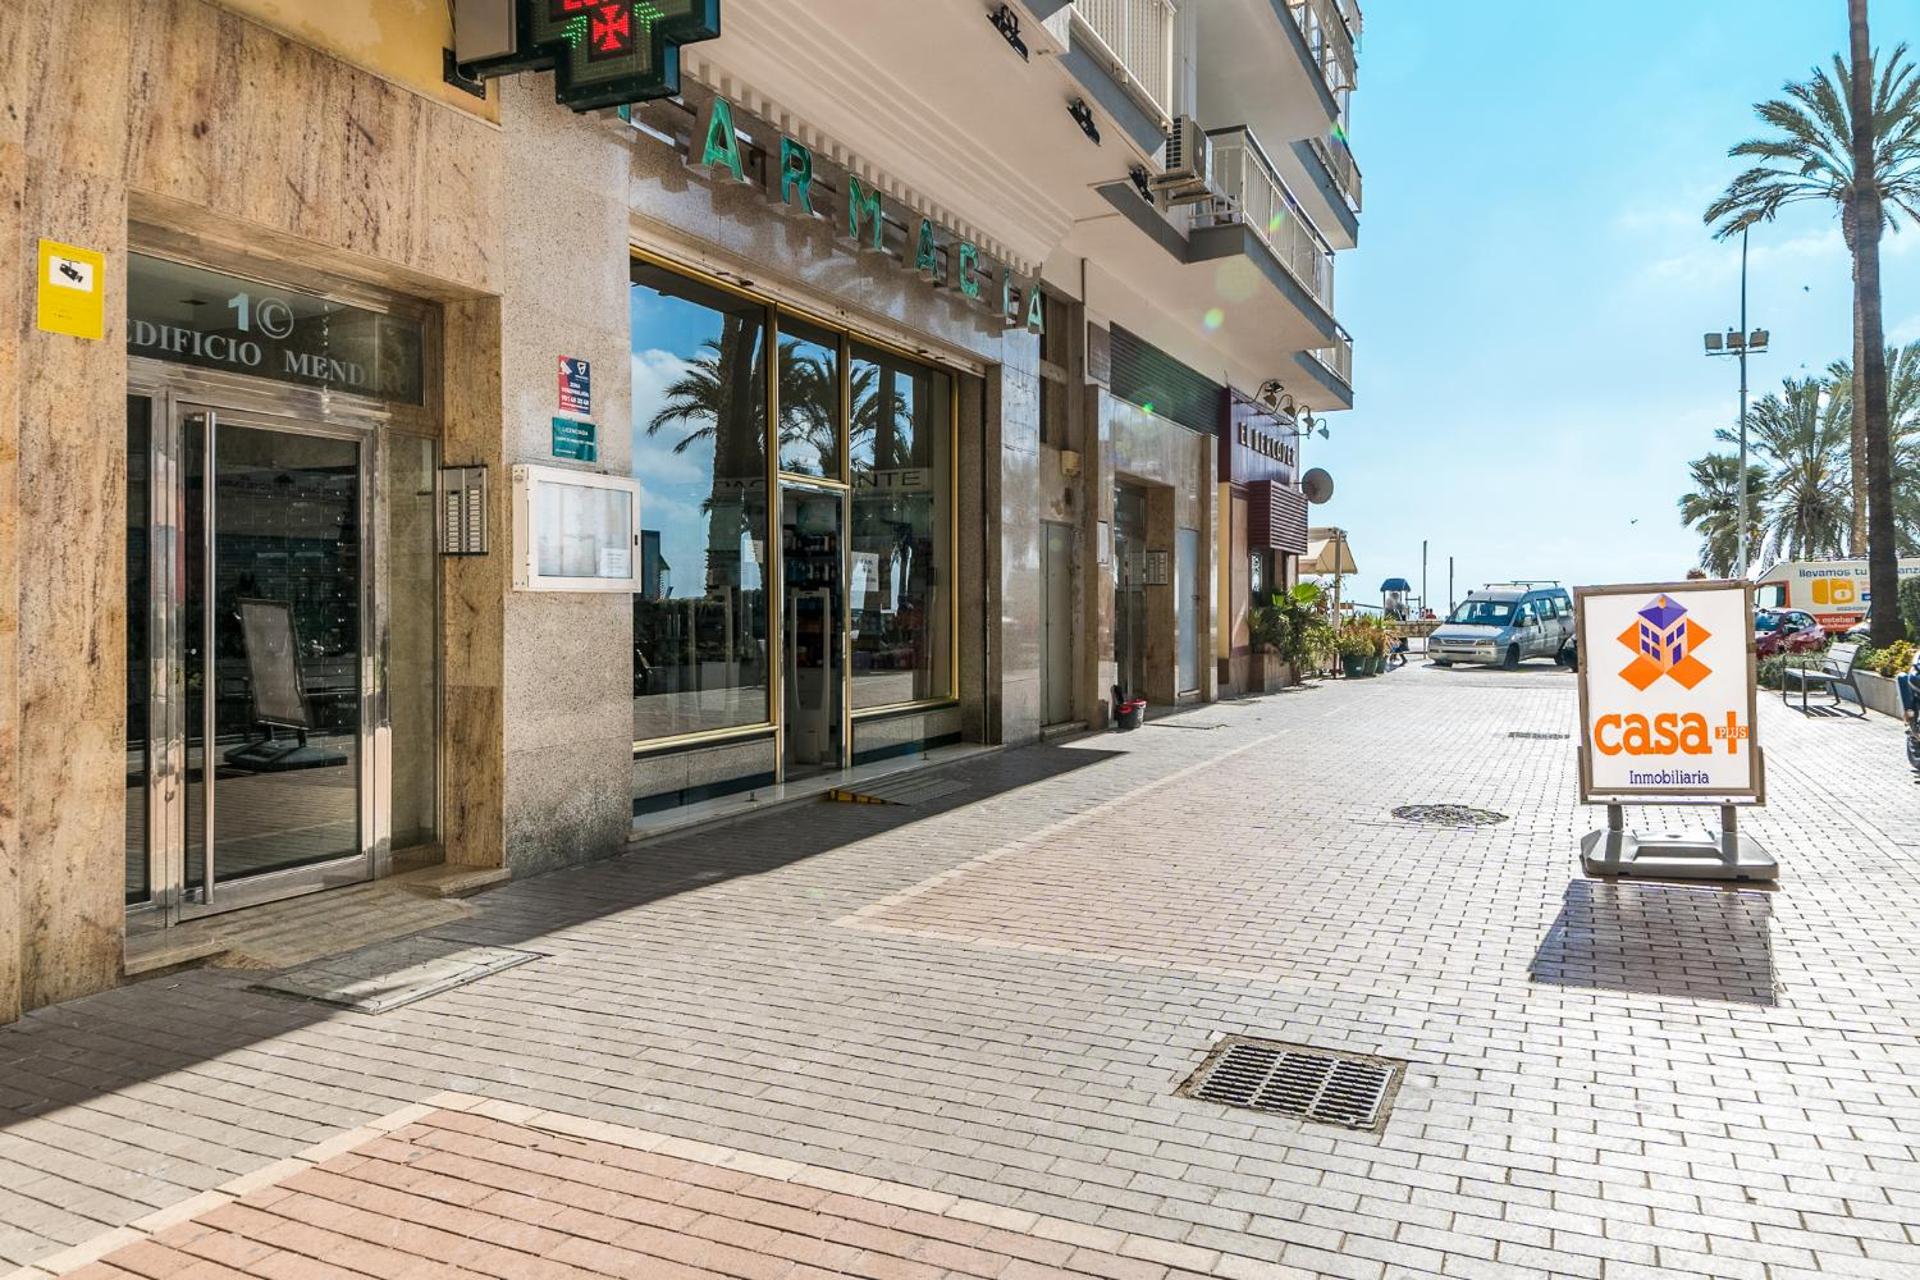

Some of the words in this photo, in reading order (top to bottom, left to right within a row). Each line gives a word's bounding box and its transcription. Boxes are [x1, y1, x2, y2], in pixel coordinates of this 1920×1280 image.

[618, 95, 1043, 334] ARMACIA
[1799, 568, 1851, 578] llevamos
[1855, 567, 1867, 576] tu
[1594, 712, 1712, 756] casa
[1718, 726, 1747, 739] PLUS
[1629, 769, 1710, 785] Inmobiliaria
